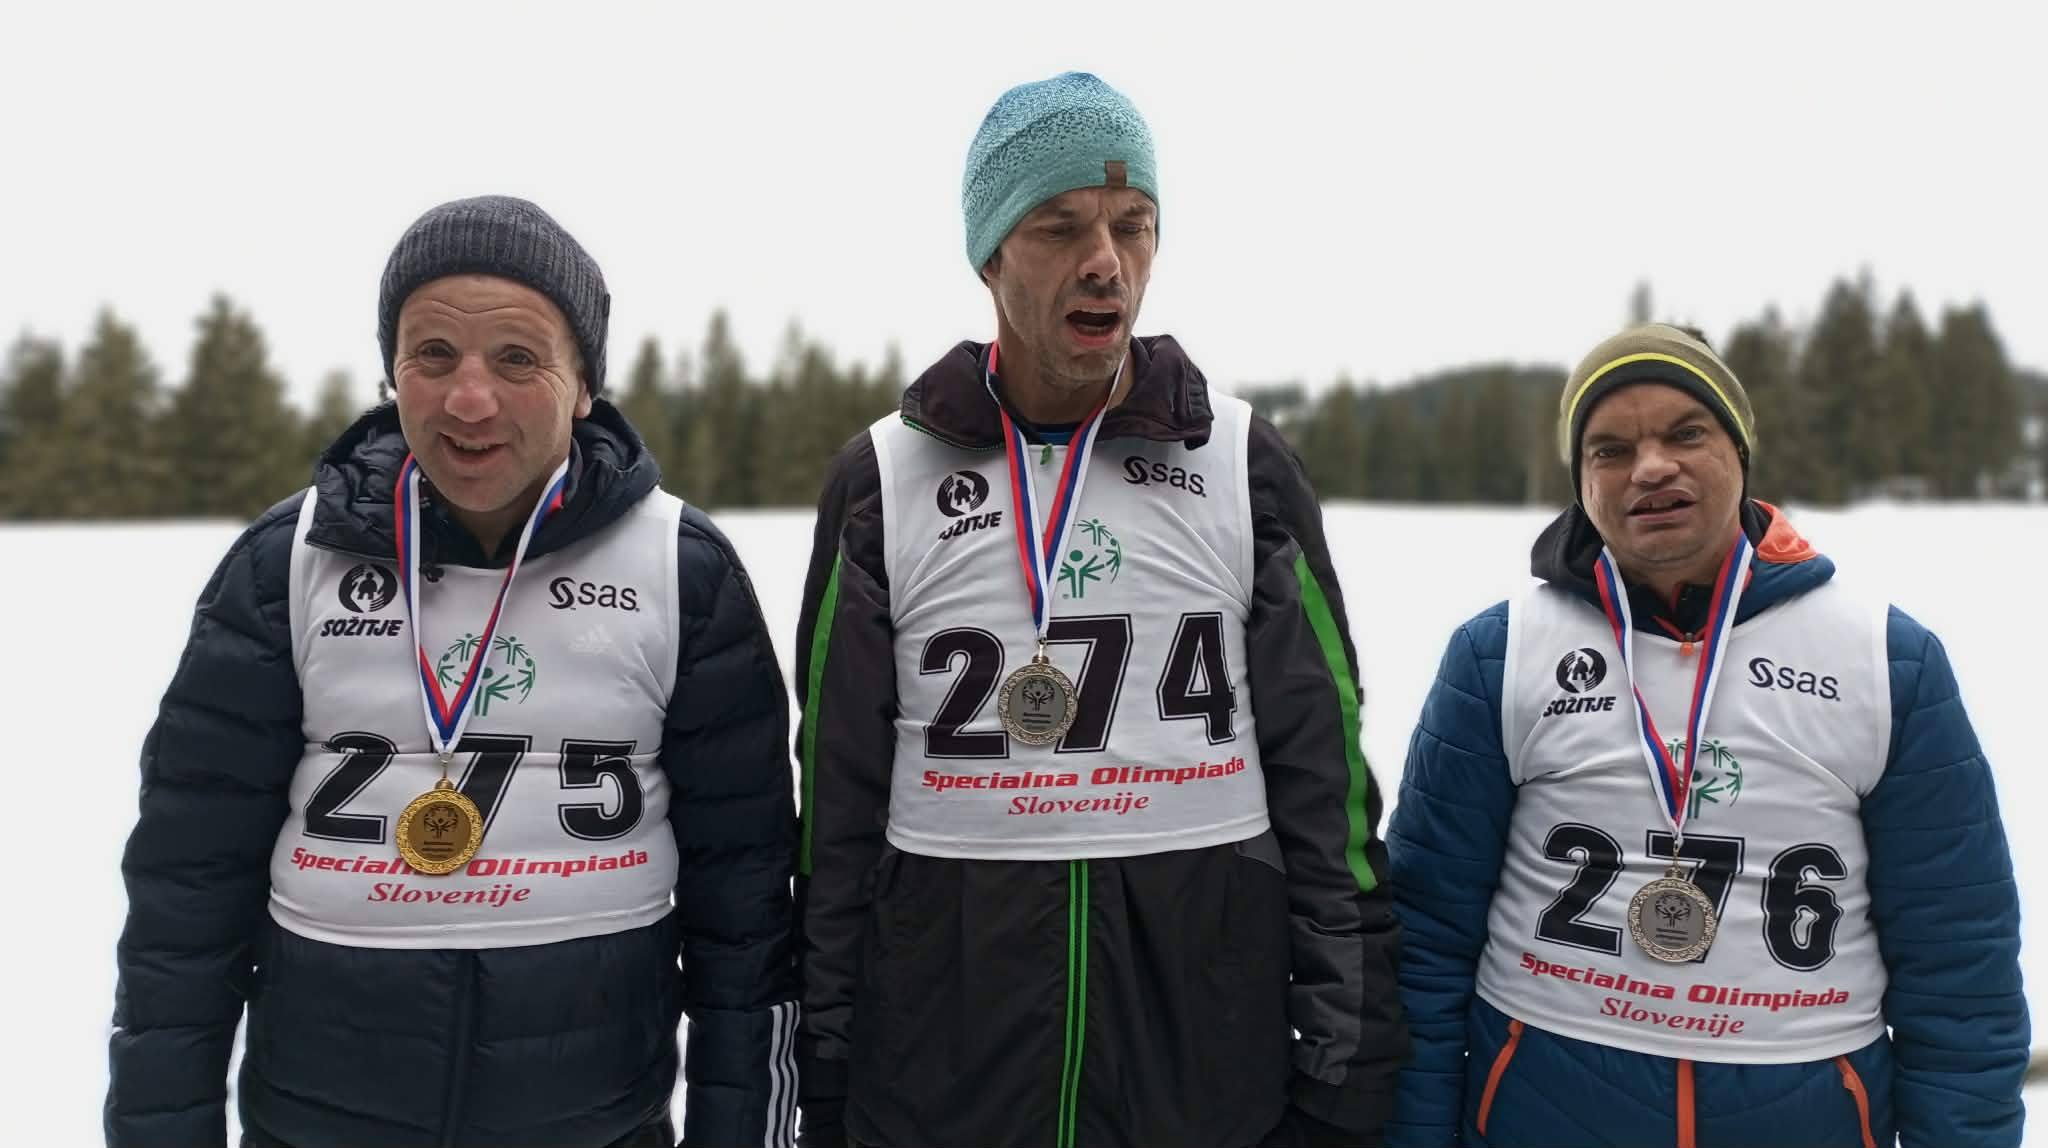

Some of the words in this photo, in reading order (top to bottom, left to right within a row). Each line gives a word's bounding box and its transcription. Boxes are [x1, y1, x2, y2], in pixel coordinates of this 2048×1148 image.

[320, 616, 403, 637] SOŽITJE
[919, 612, 1237, 759] 274
[302, 732, 645, 846] 275
[922, 769, 1078, 792] Specialna
[1091, 756, 1245, 785] Olimpiada
[1008, 792, 1149, 815] Slovenije
[290, 847, 414, 875] Special
[466, 849, 648, 877] Olimpiada
[367, 882, 531, 907] Slovenije
[1534, 822, 1848, 972] 276
[1520, 952, 1675, 1000] Specialna
[1687, 984, 1850, 1012] Olimpiada
[1600, 997, 1745, 1038] Slovenije
